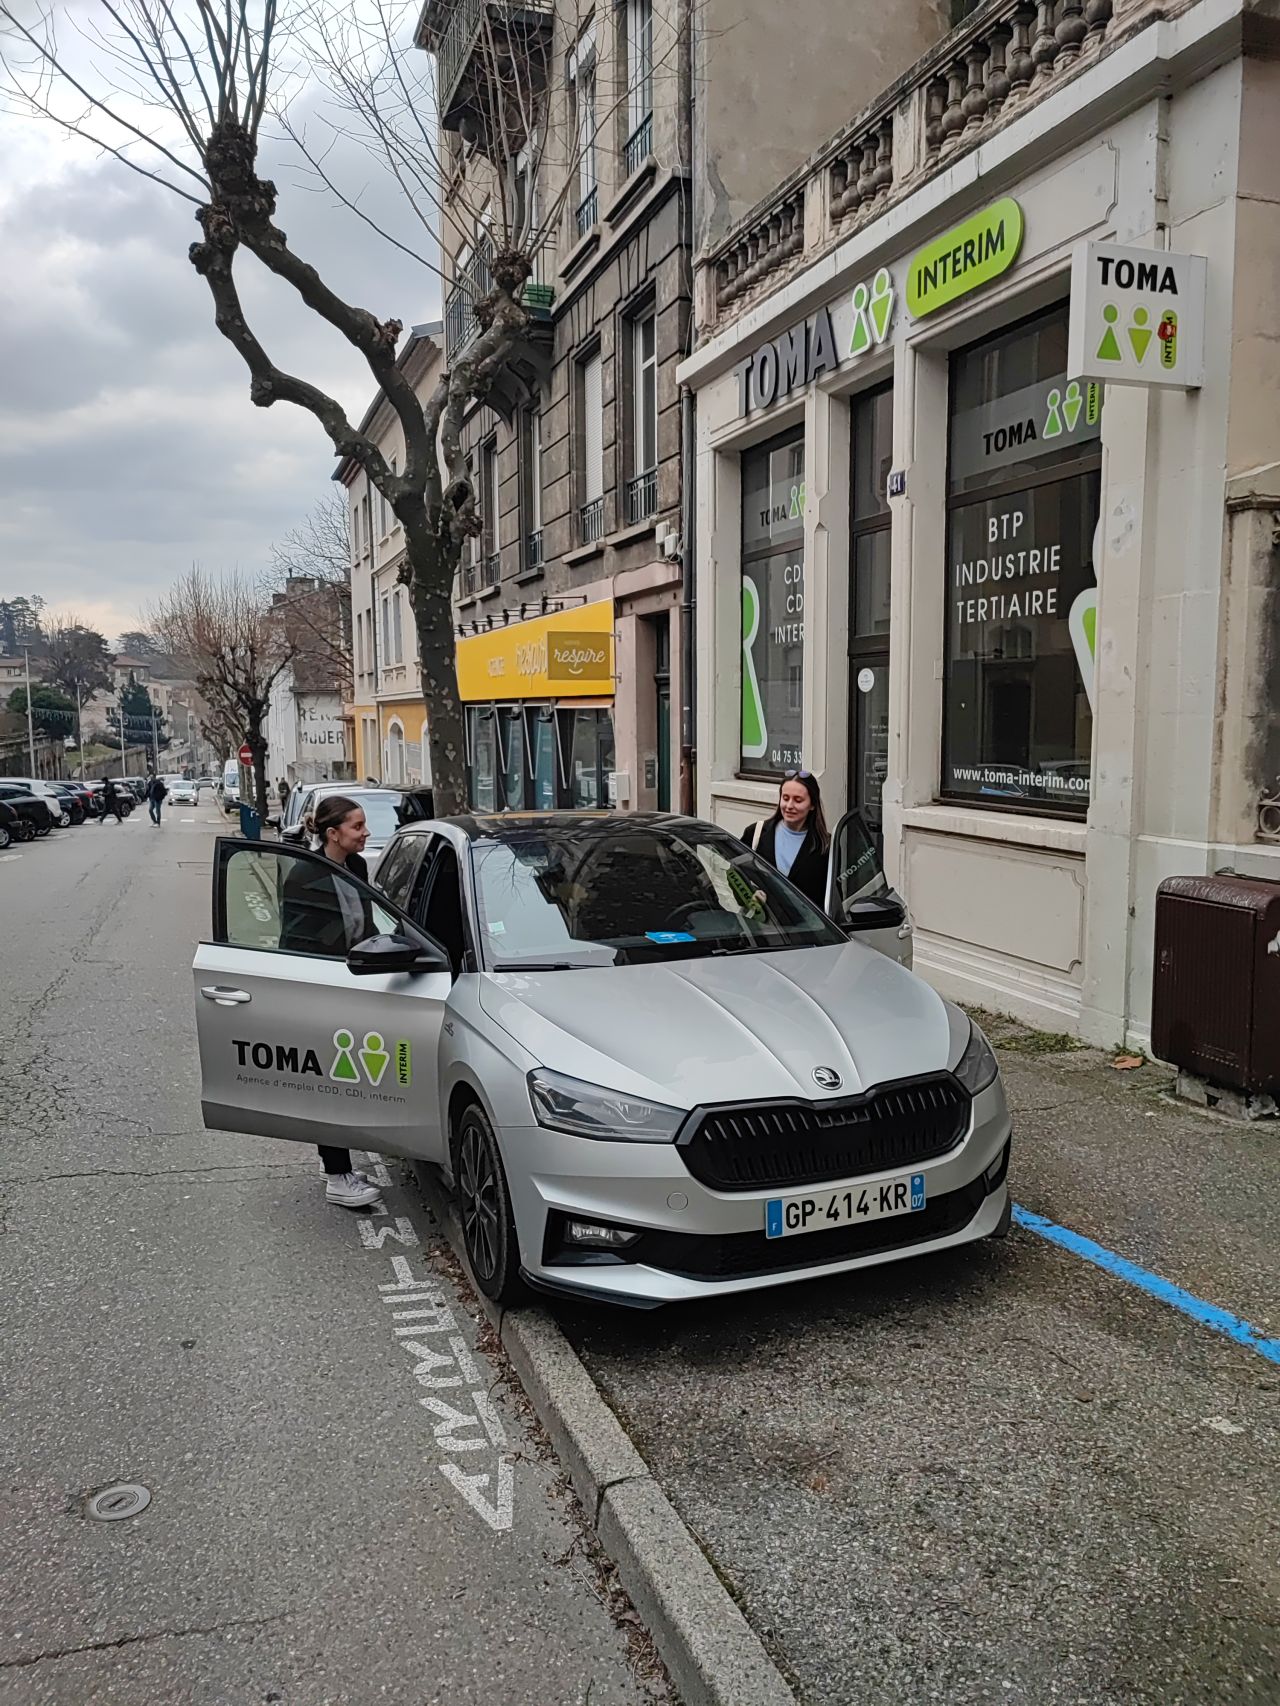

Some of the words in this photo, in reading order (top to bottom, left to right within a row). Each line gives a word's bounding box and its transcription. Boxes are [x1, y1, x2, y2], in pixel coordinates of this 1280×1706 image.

[917, 218, 1005, 299] INTERIM
[1097, 256, 1178, 296] TOMA
[1164, 316, 1174, 363] INTEM
[734, 306, 838, 420] TOMA
[983, 418, 1037, 456] TOMA
[988, 511, 1024, 543] BTP
[956, 545, 1061, 588] INDUSTRIE
[957, 588, 1057, 624] TERTIAIRE
[554, 648, 606, 668] respire
[772, 749, 781, 763] 04
[783, 750, 792, 764] 75
[232, 1040, 323, 1076] TOMA
[399, 1043, 408, 1084] INTERIM
[236, 1073, 270, 1086] Agence
[273, 1080, 315, 1093] d'emploi
[785, 1182, 908, 1230] GP-414-KR
[911, 1193, 924, 1208] 07
